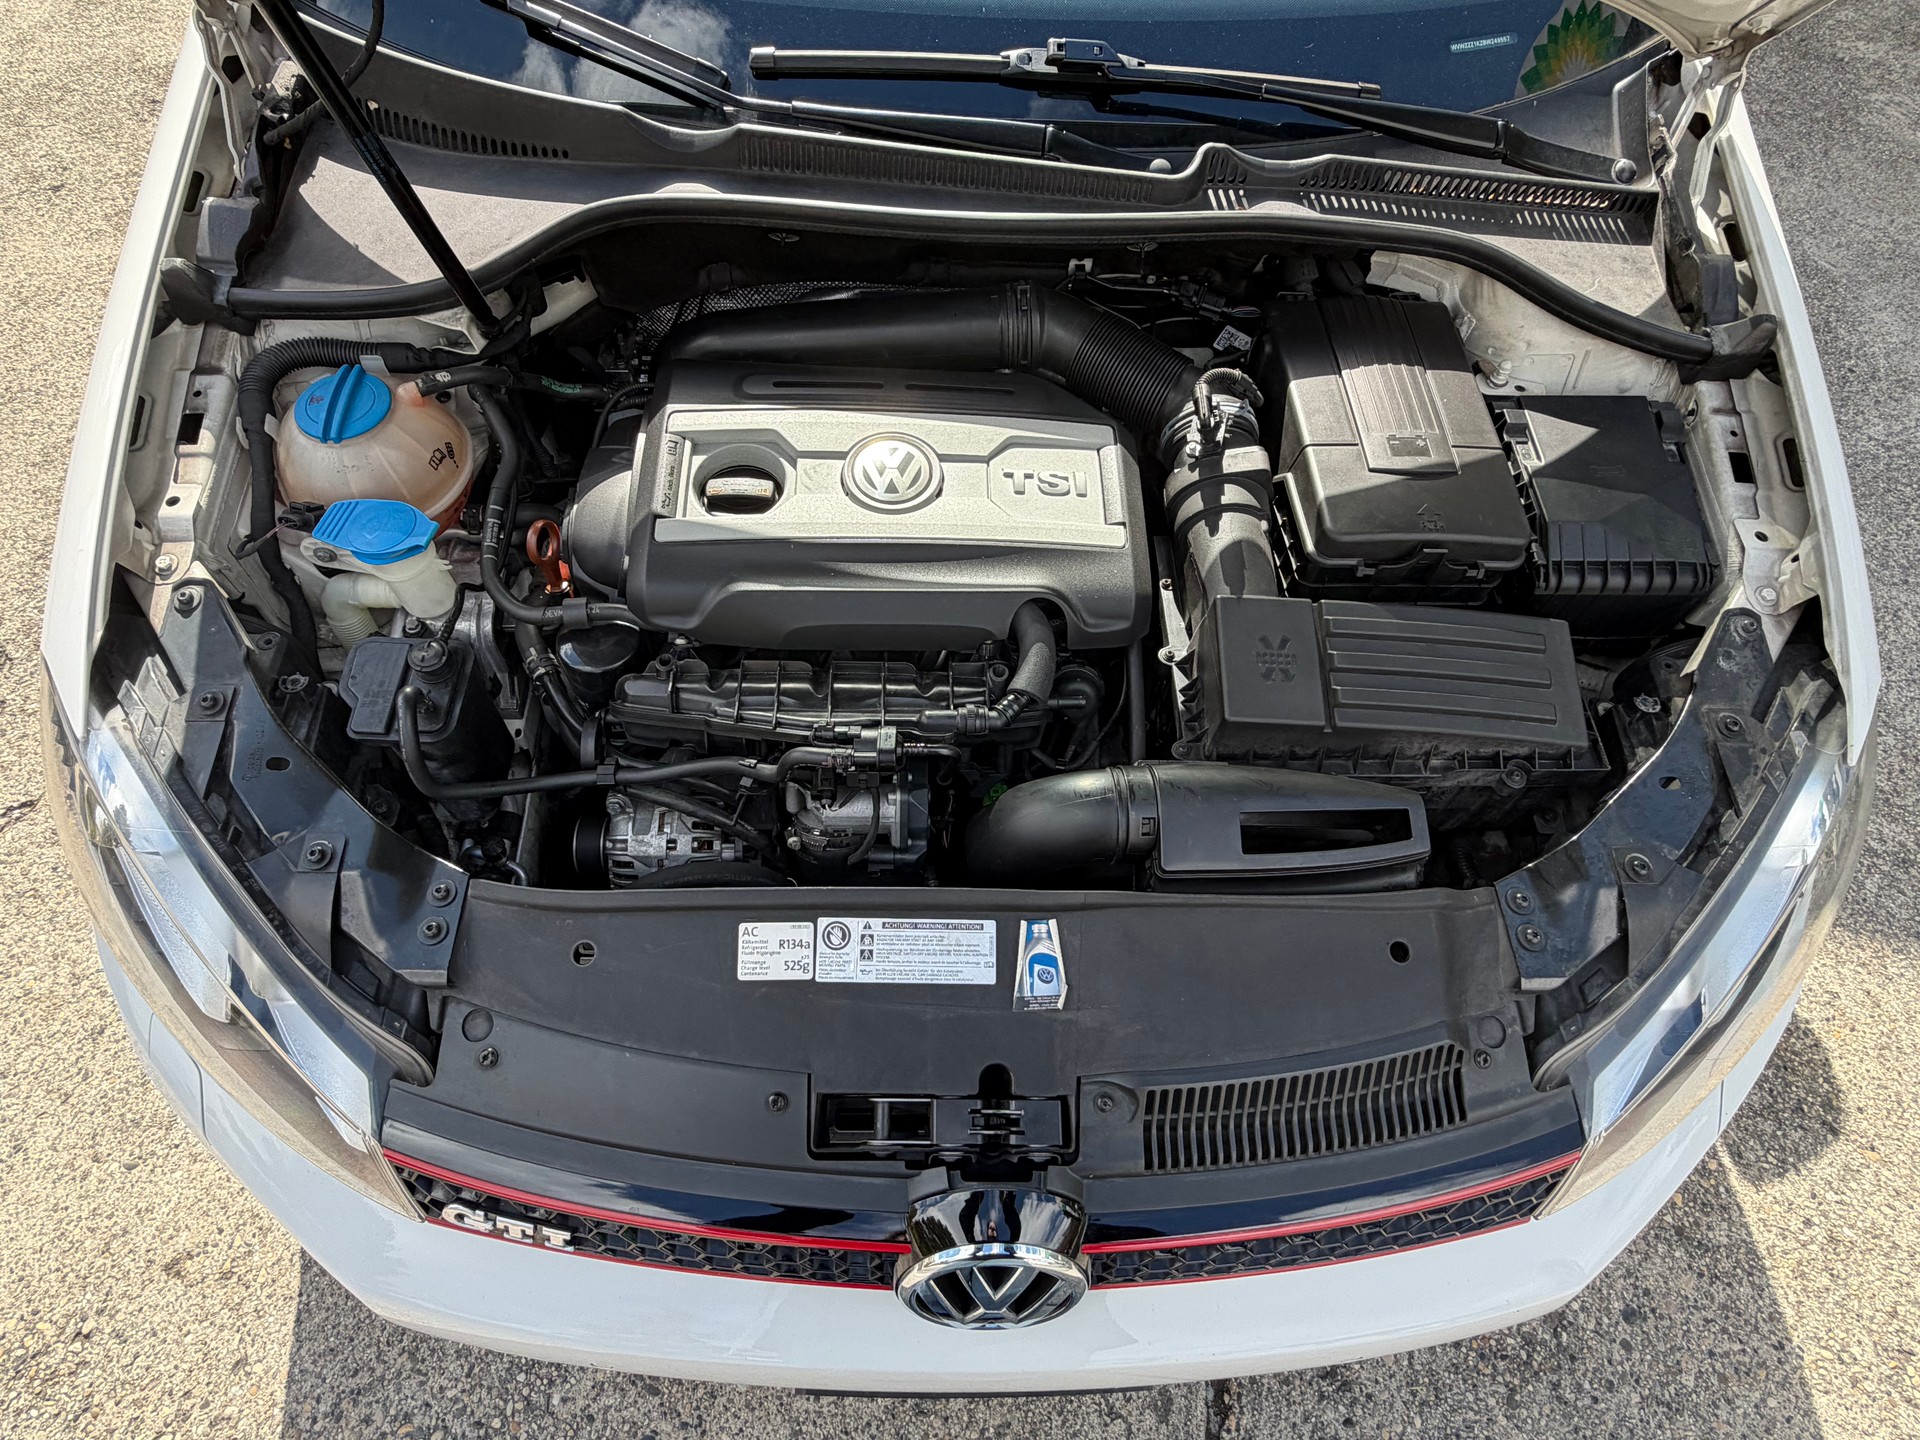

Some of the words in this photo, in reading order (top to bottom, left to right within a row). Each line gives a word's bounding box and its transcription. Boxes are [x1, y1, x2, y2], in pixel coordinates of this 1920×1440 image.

[1002, 469, 1088, 498] TSI
[741, 926, 759, 937] AC
[778, 938, 811, 950] R134a
[783, 960, 810, 974] 525g
[1037, 967, 1055, 985] VW
[441, 1203, 574, 1252] GTI
[900, 1252, 1086, 1330] VW
